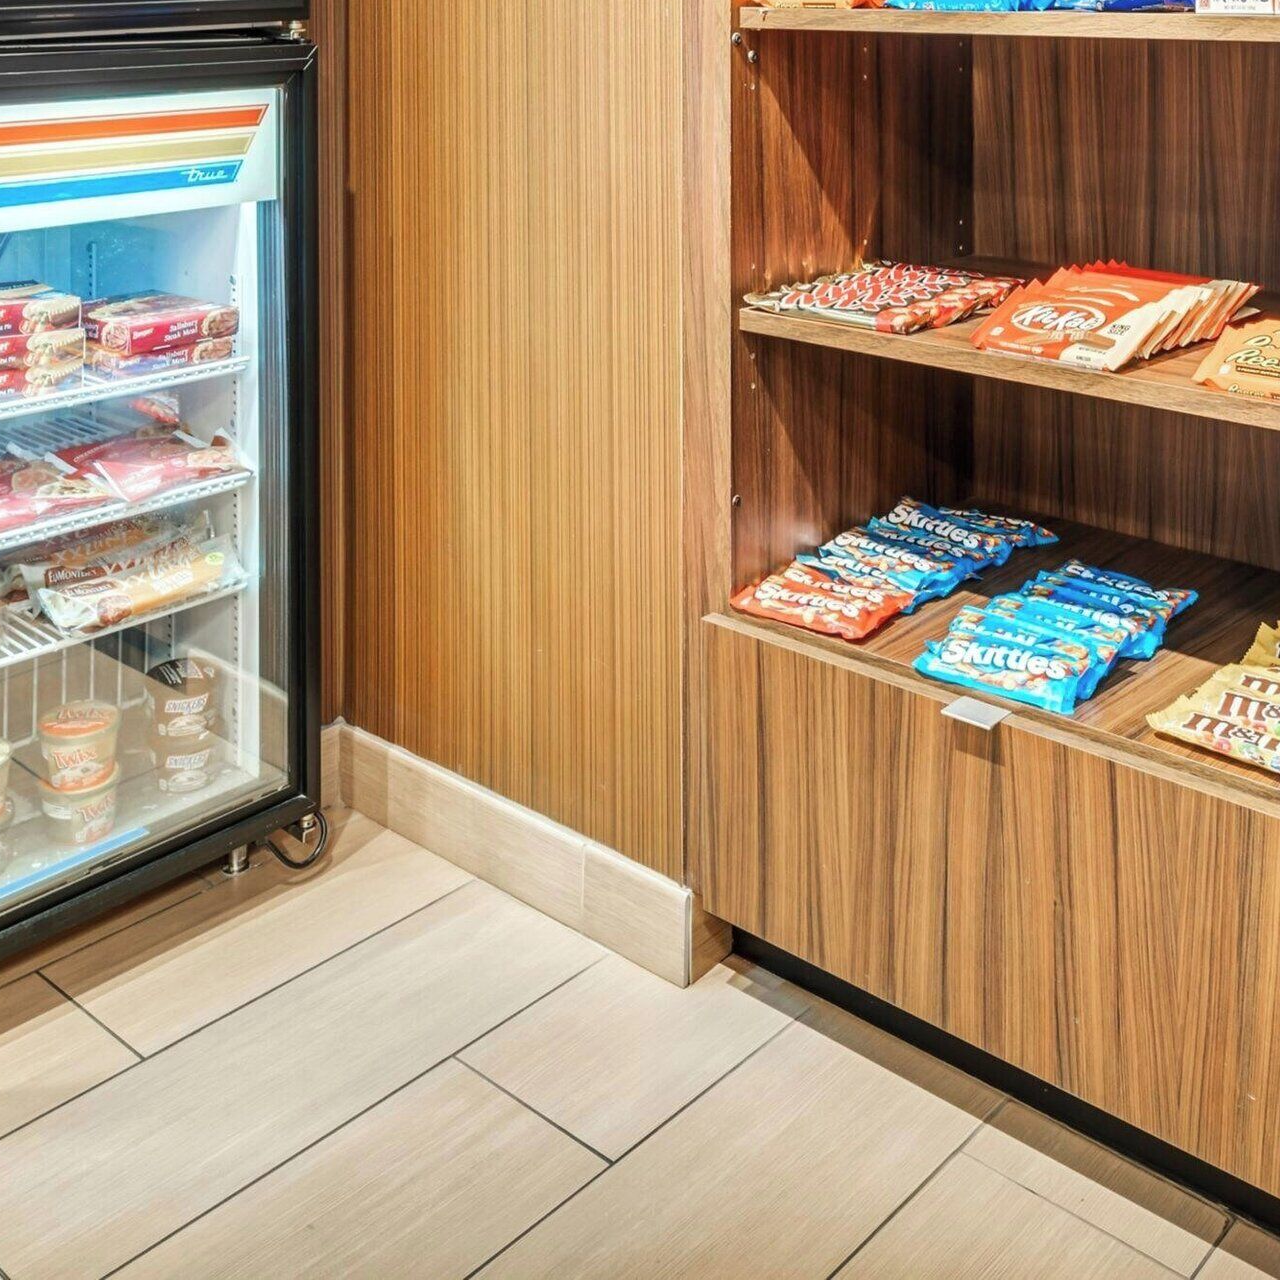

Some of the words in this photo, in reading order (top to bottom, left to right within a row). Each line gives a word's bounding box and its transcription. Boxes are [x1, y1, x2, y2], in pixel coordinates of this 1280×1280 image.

[179, 167, 228, 183] true
[889, 505, 981, 549] Skittles
[835, 531, 935, 572] Skittles
[755, 581, 861, 619] Skittles
[940, 639, 1068, 681] Skittles
[164, 694, 210, 713] SNICKERS
[51, 746, 99, 769] Twix
[164, 749, 212, 769] SNICKERS
